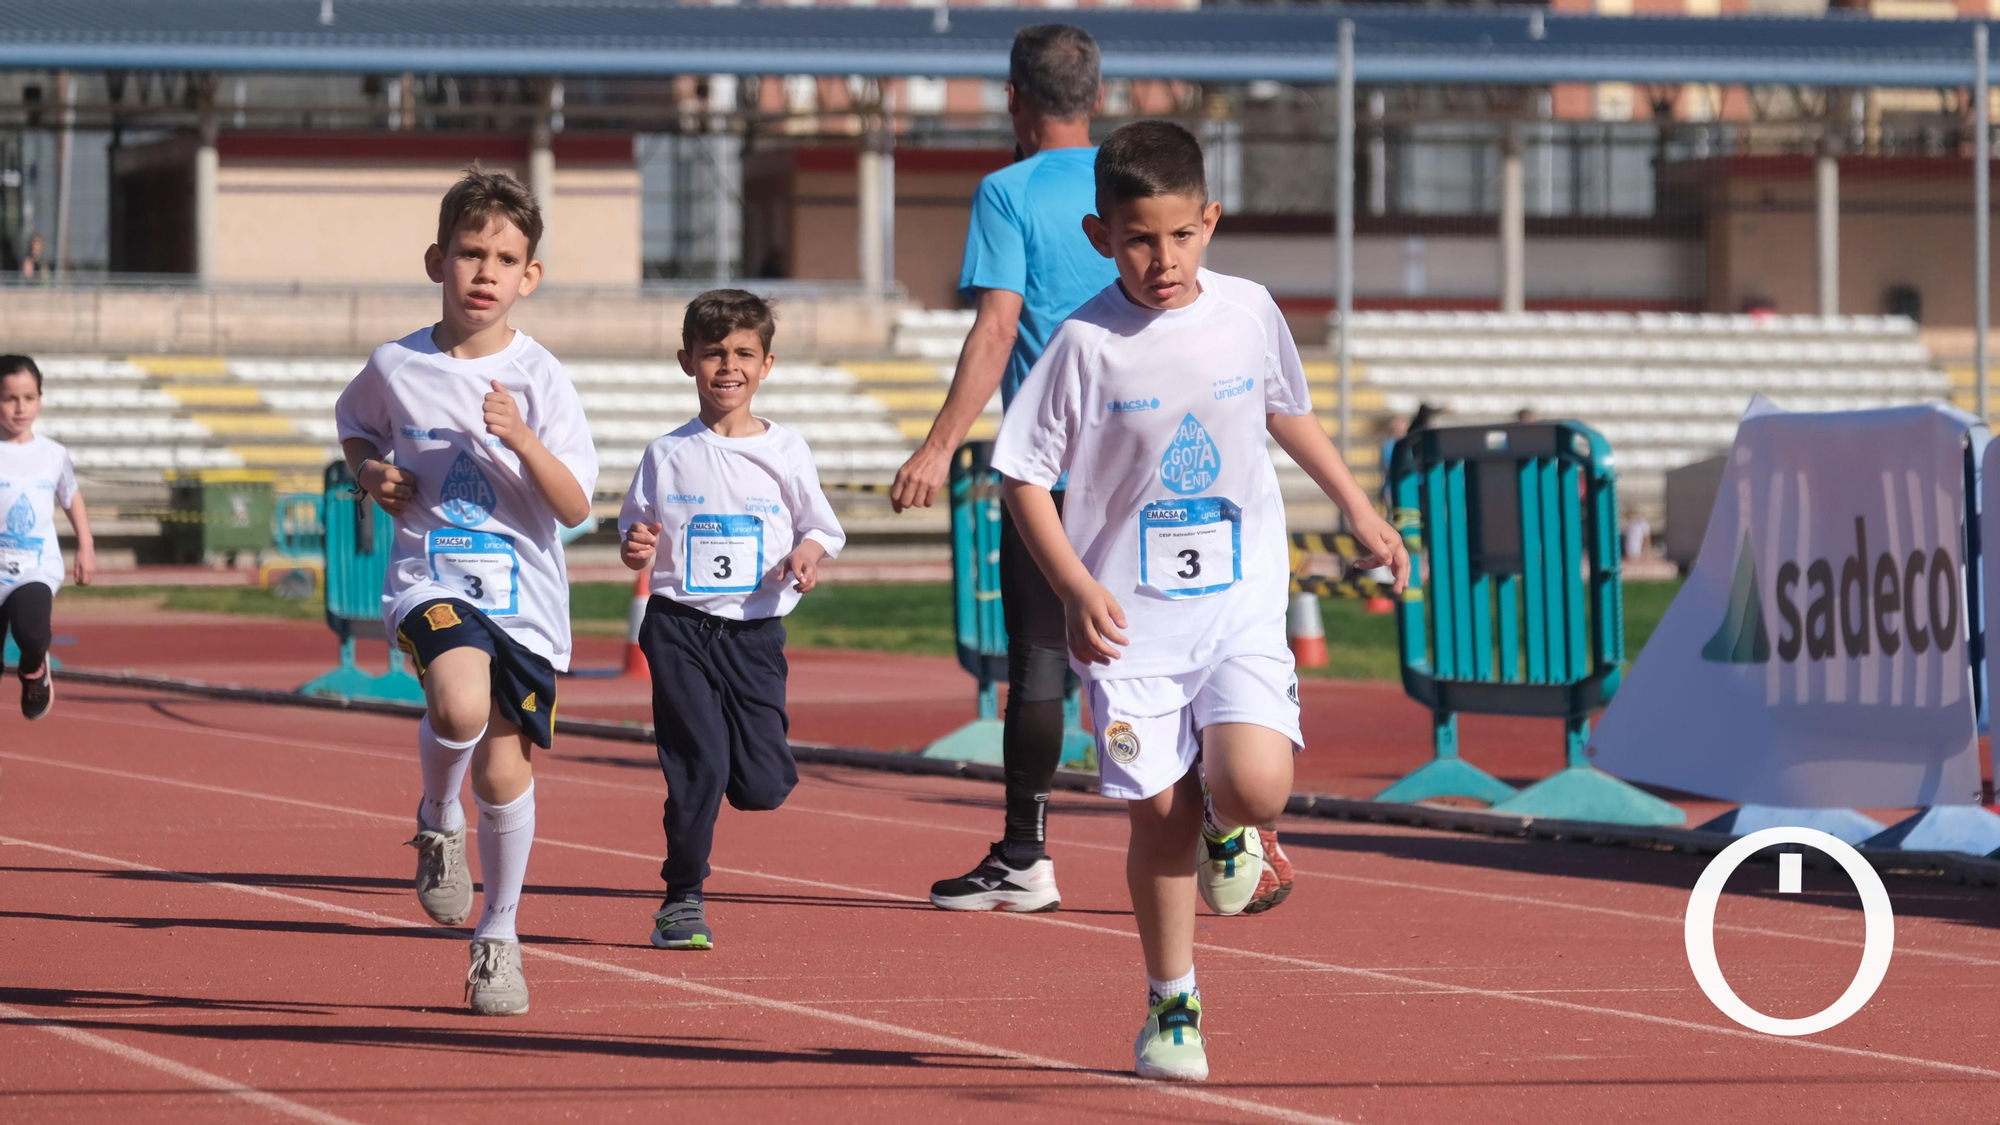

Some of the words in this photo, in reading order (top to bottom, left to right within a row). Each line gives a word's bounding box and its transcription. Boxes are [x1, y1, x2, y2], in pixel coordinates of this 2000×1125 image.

[1214, 380, 1247, 400] unicef
[1107, 399, 1150, 410] EMACSA
[1174, 421, 1207, 446] CADA
[1171, 443, 1216, 469] GOTA
[450, 459, 480, 481] CADA
[448, 480, 492, 503] GOTA
[745, 503, 772, 513] unicef
[1147, 511, 1179, 519] EMACSA
[713, 555, 732, 579] 3
[1177, 549, 1201, 579] 3
[463, 575, 484, 599] 3
[1776, 514, 1958, 663] sadeco
